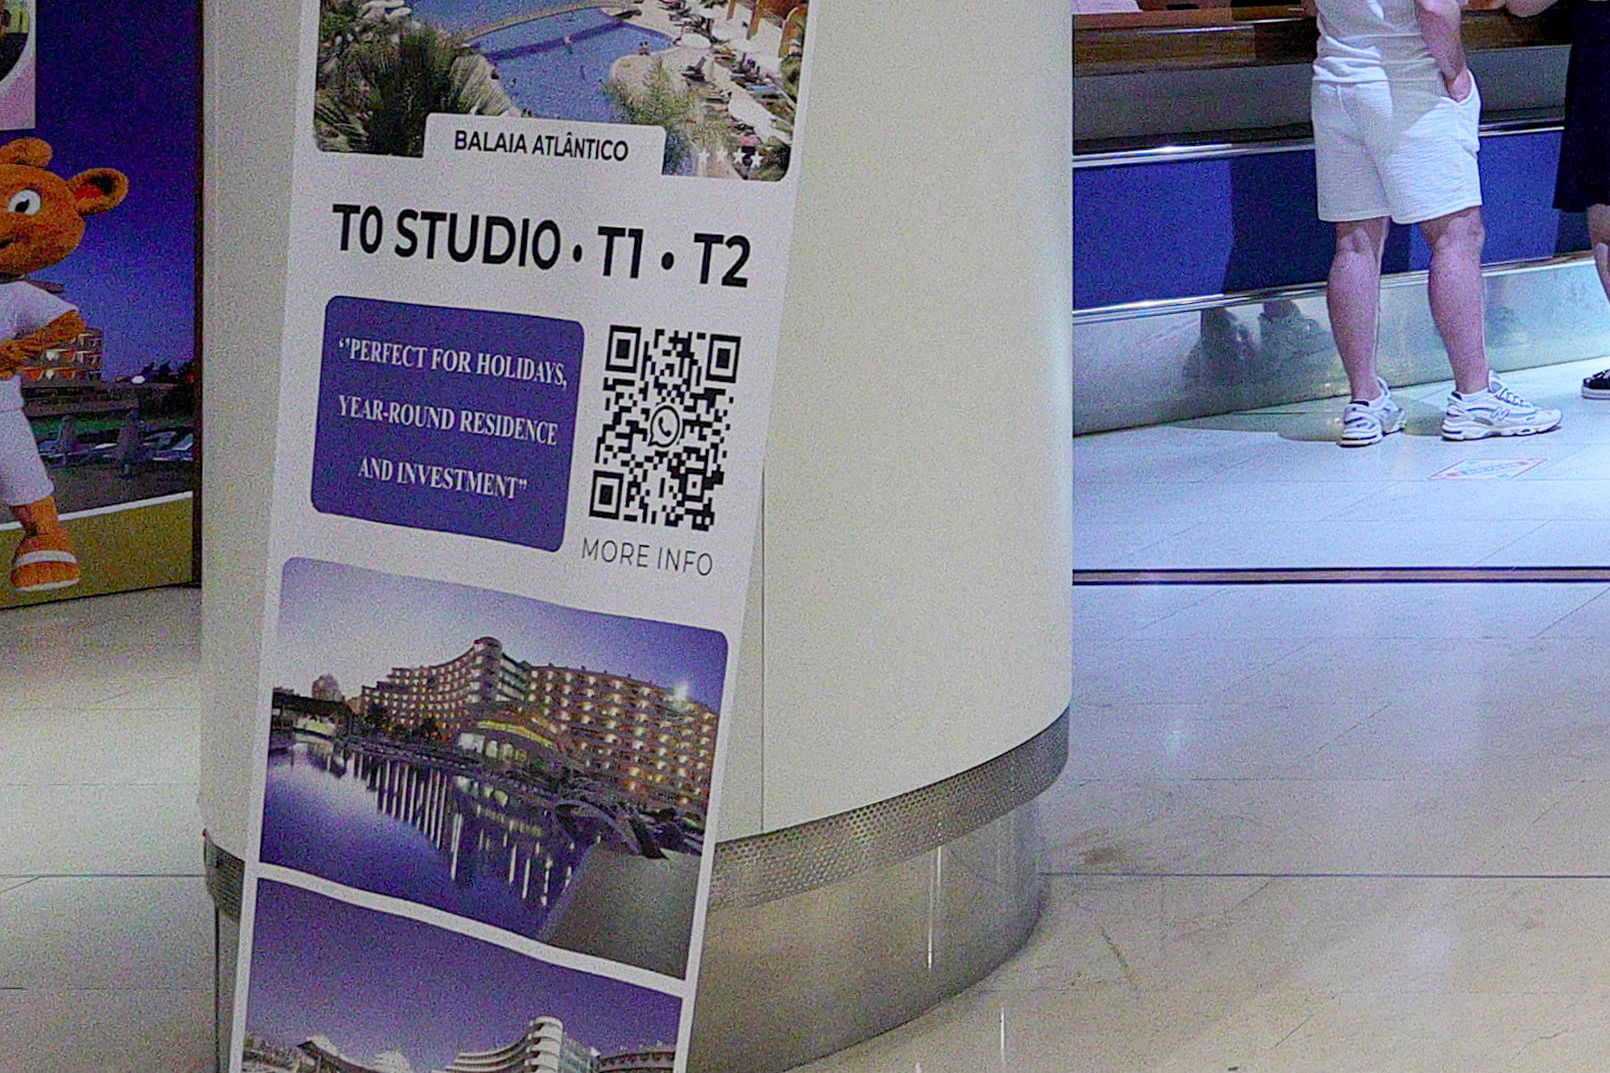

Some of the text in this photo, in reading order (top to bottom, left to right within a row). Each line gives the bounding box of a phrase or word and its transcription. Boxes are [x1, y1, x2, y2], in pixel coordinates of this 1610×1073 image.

[454, 130, 629, 162] BALAIA ATLÂNTICO
[394, 208, 562, 270] STUDIO
[598, 226, 644, 279] T1
[693, 232, 751, 288] T2
[431, 348, 471, 374] FOR
[476, 352, 567, 390] HOLIDAYS,
[338, 394, 559, 446] YEAR-ROUND RESIDENCE
[358, 457, 393, 482] AND
[582, 537, 713, 576] MORE INFO
